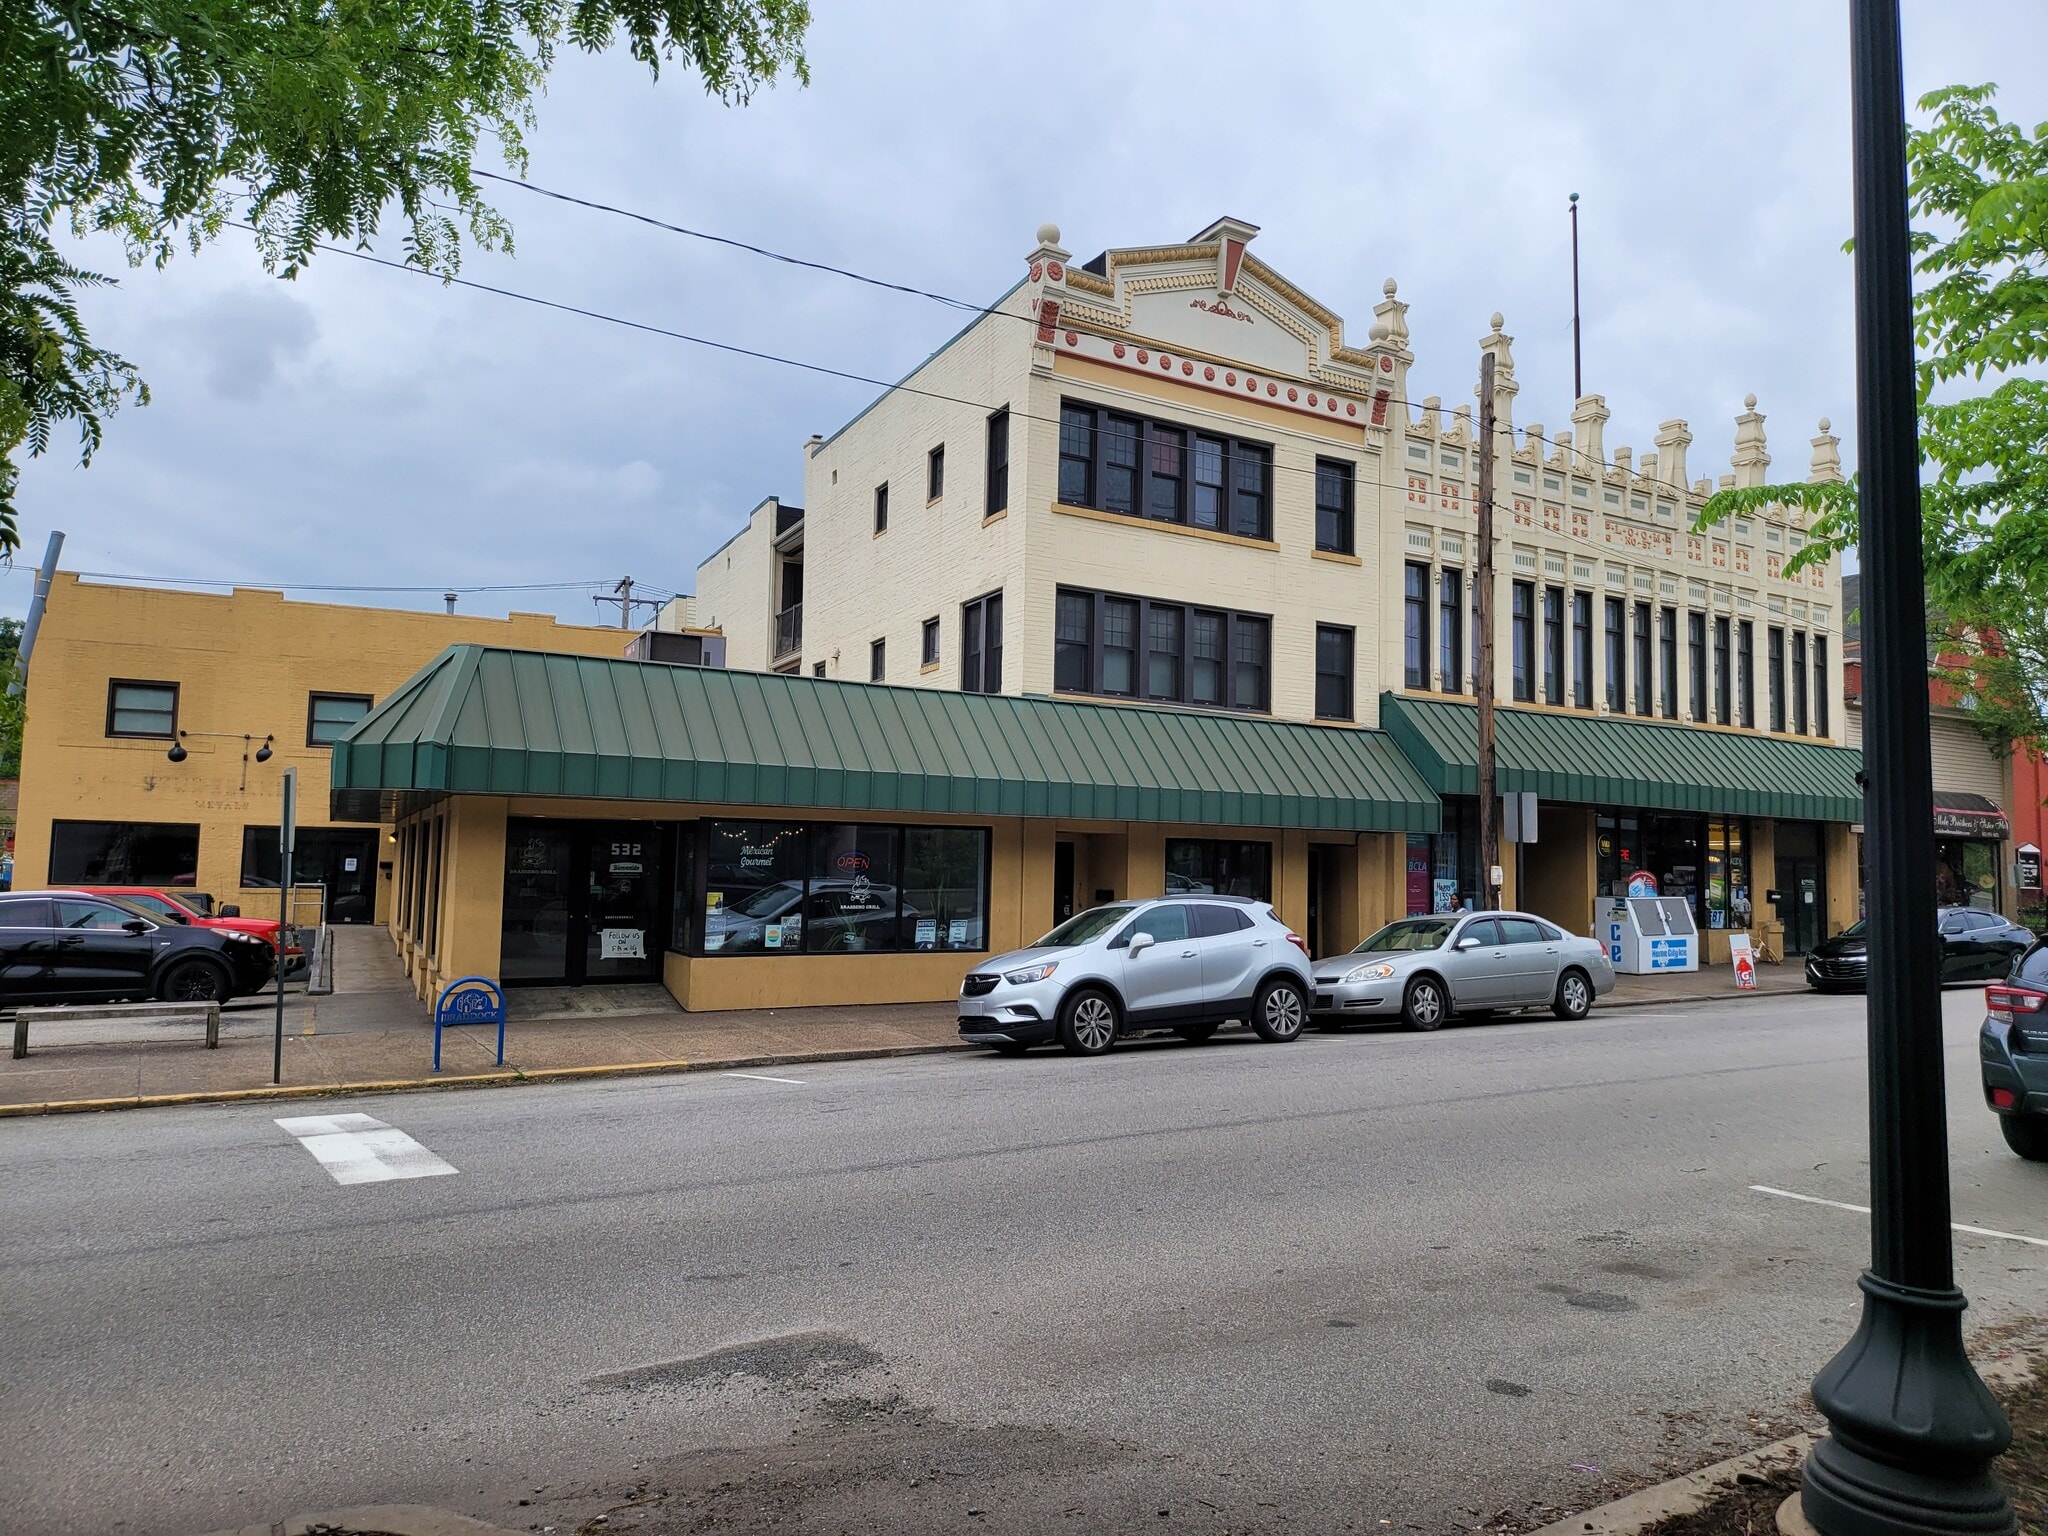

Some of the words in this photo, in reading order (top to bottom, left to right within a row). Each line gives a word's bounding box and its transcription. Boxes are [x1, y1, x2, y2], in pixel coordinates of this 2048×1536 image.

[611, 843, 641, 855] 532
[740, 846, 773, 855] Mexican
[740, 857, 775, 867] Gourmet
[837, 856, 870, 869] OPEN
[1408, 861, 1427, 871] BCLA
[1652, 949, 1667, 957] Home
[441, 1011, 498, 1022] BRADDOCK
